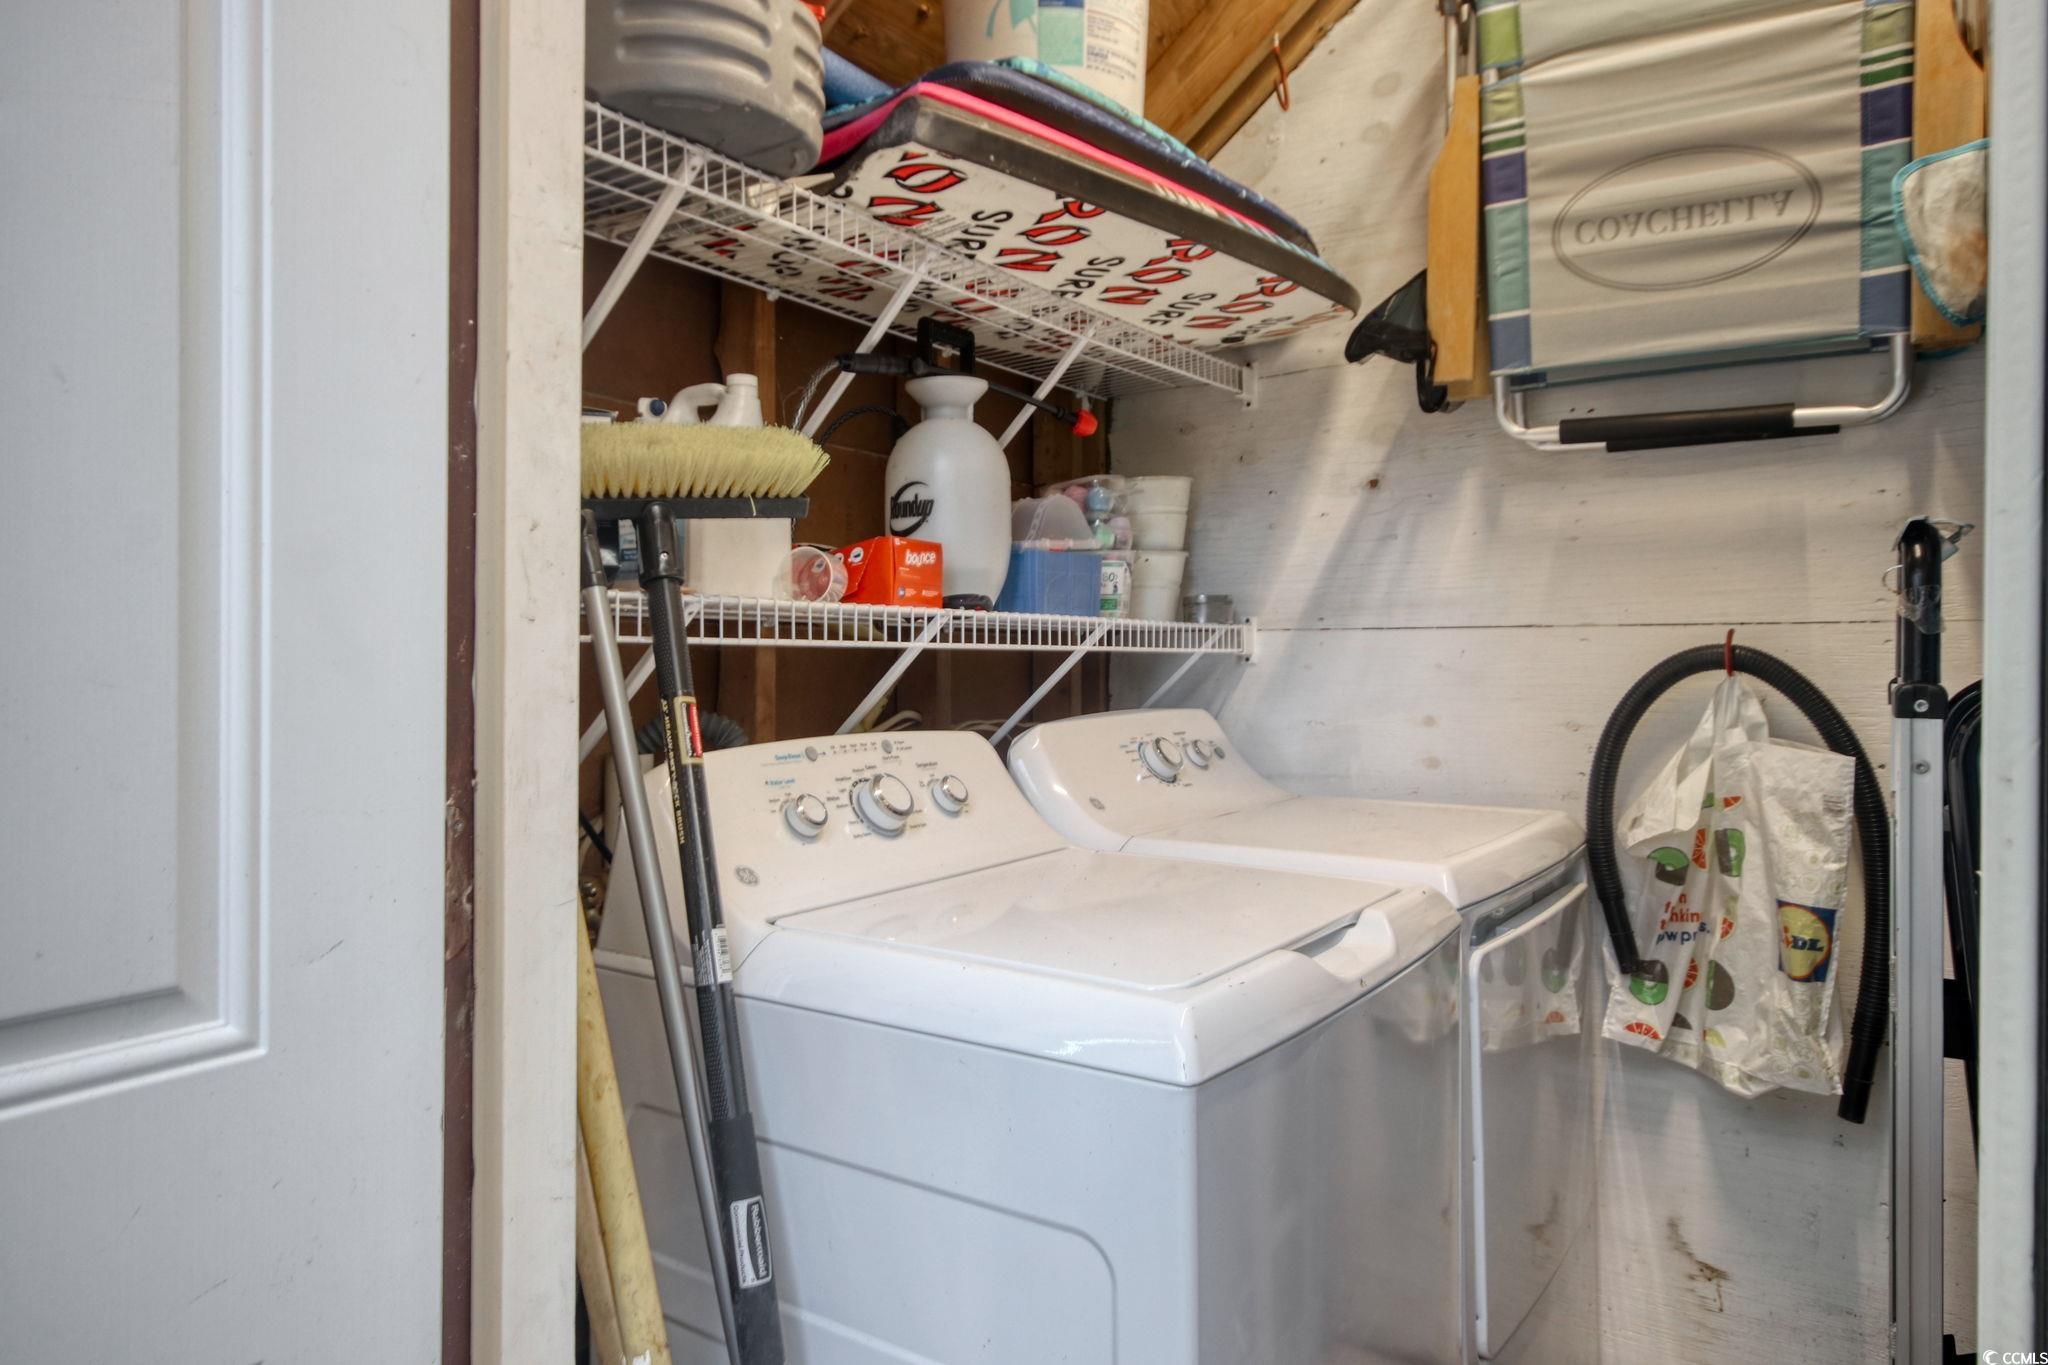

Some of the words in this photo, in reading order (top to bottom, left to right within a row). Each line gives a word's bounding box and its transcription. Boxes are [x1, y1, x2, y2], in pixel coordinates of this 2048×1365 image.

[1098, 237, 1217, 306] RON
[1143, 292, 1217, 326] SURF
[1184, 276, 1300, 329] RON
[890, 493, 935, 520] Roundup
[905, 549, 936, 566] bounce
[751, 1204, 767, 1277] Rubbermaid
